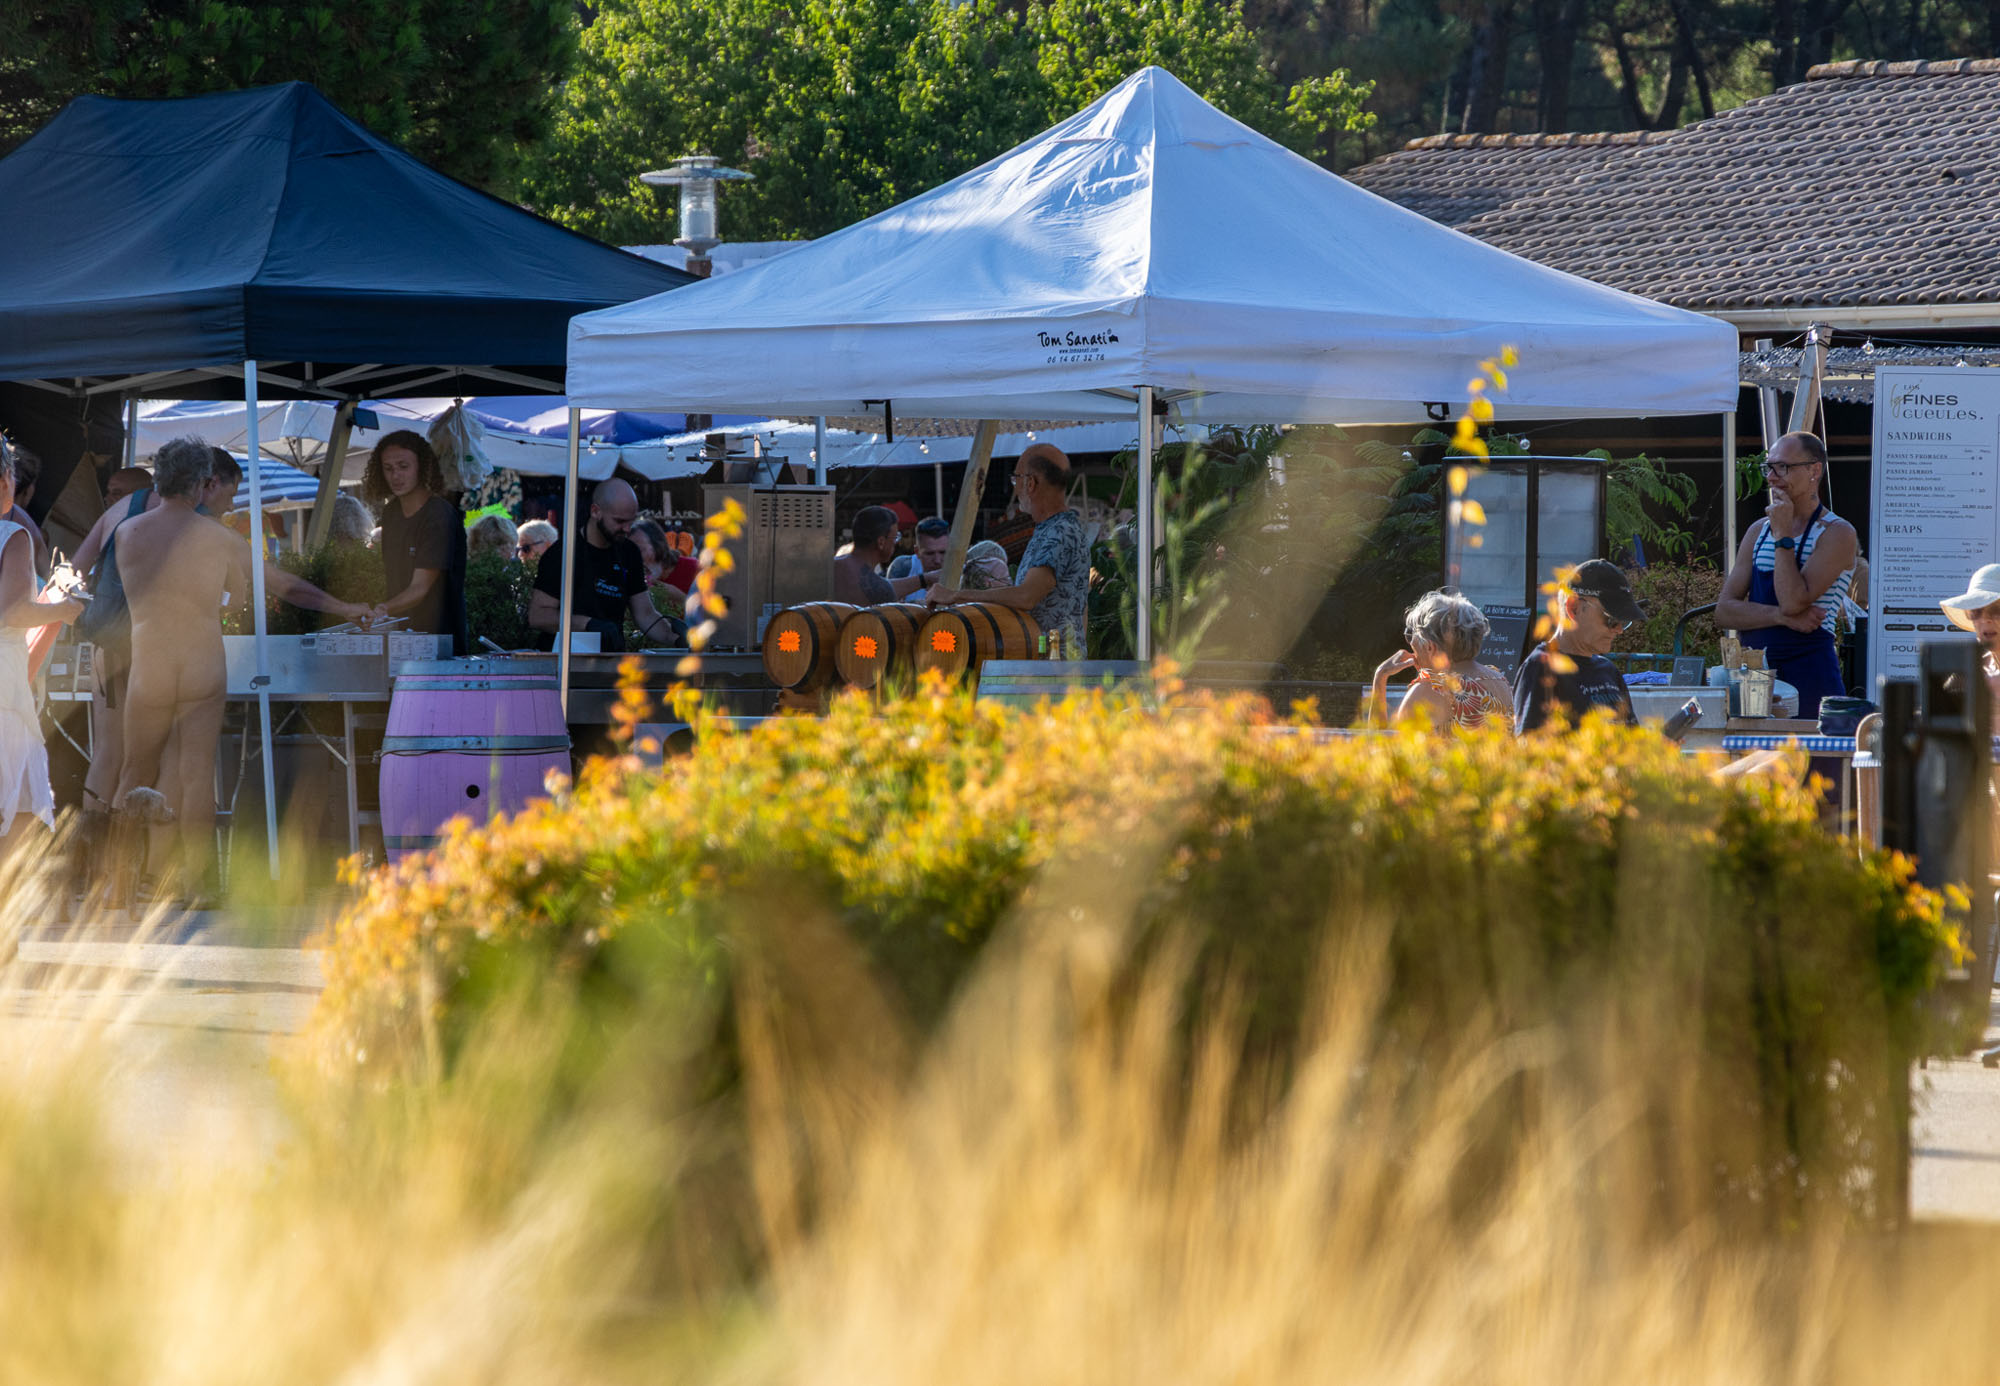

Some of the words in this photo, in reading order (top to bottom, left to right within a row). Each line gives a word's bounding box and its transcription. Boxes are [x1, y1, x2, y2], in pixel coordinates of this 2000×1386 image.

[1037, 331, 1062, 347] Tom
[1066, 330, 1107, 346] Sanati
[1047, 356, 1056, 364] 06
[1903, 394, 1958, 406] FINES
[1887, 431, 1952, 441] SANDWICHS
[1885, 524, 1923, 534] WRAPS
